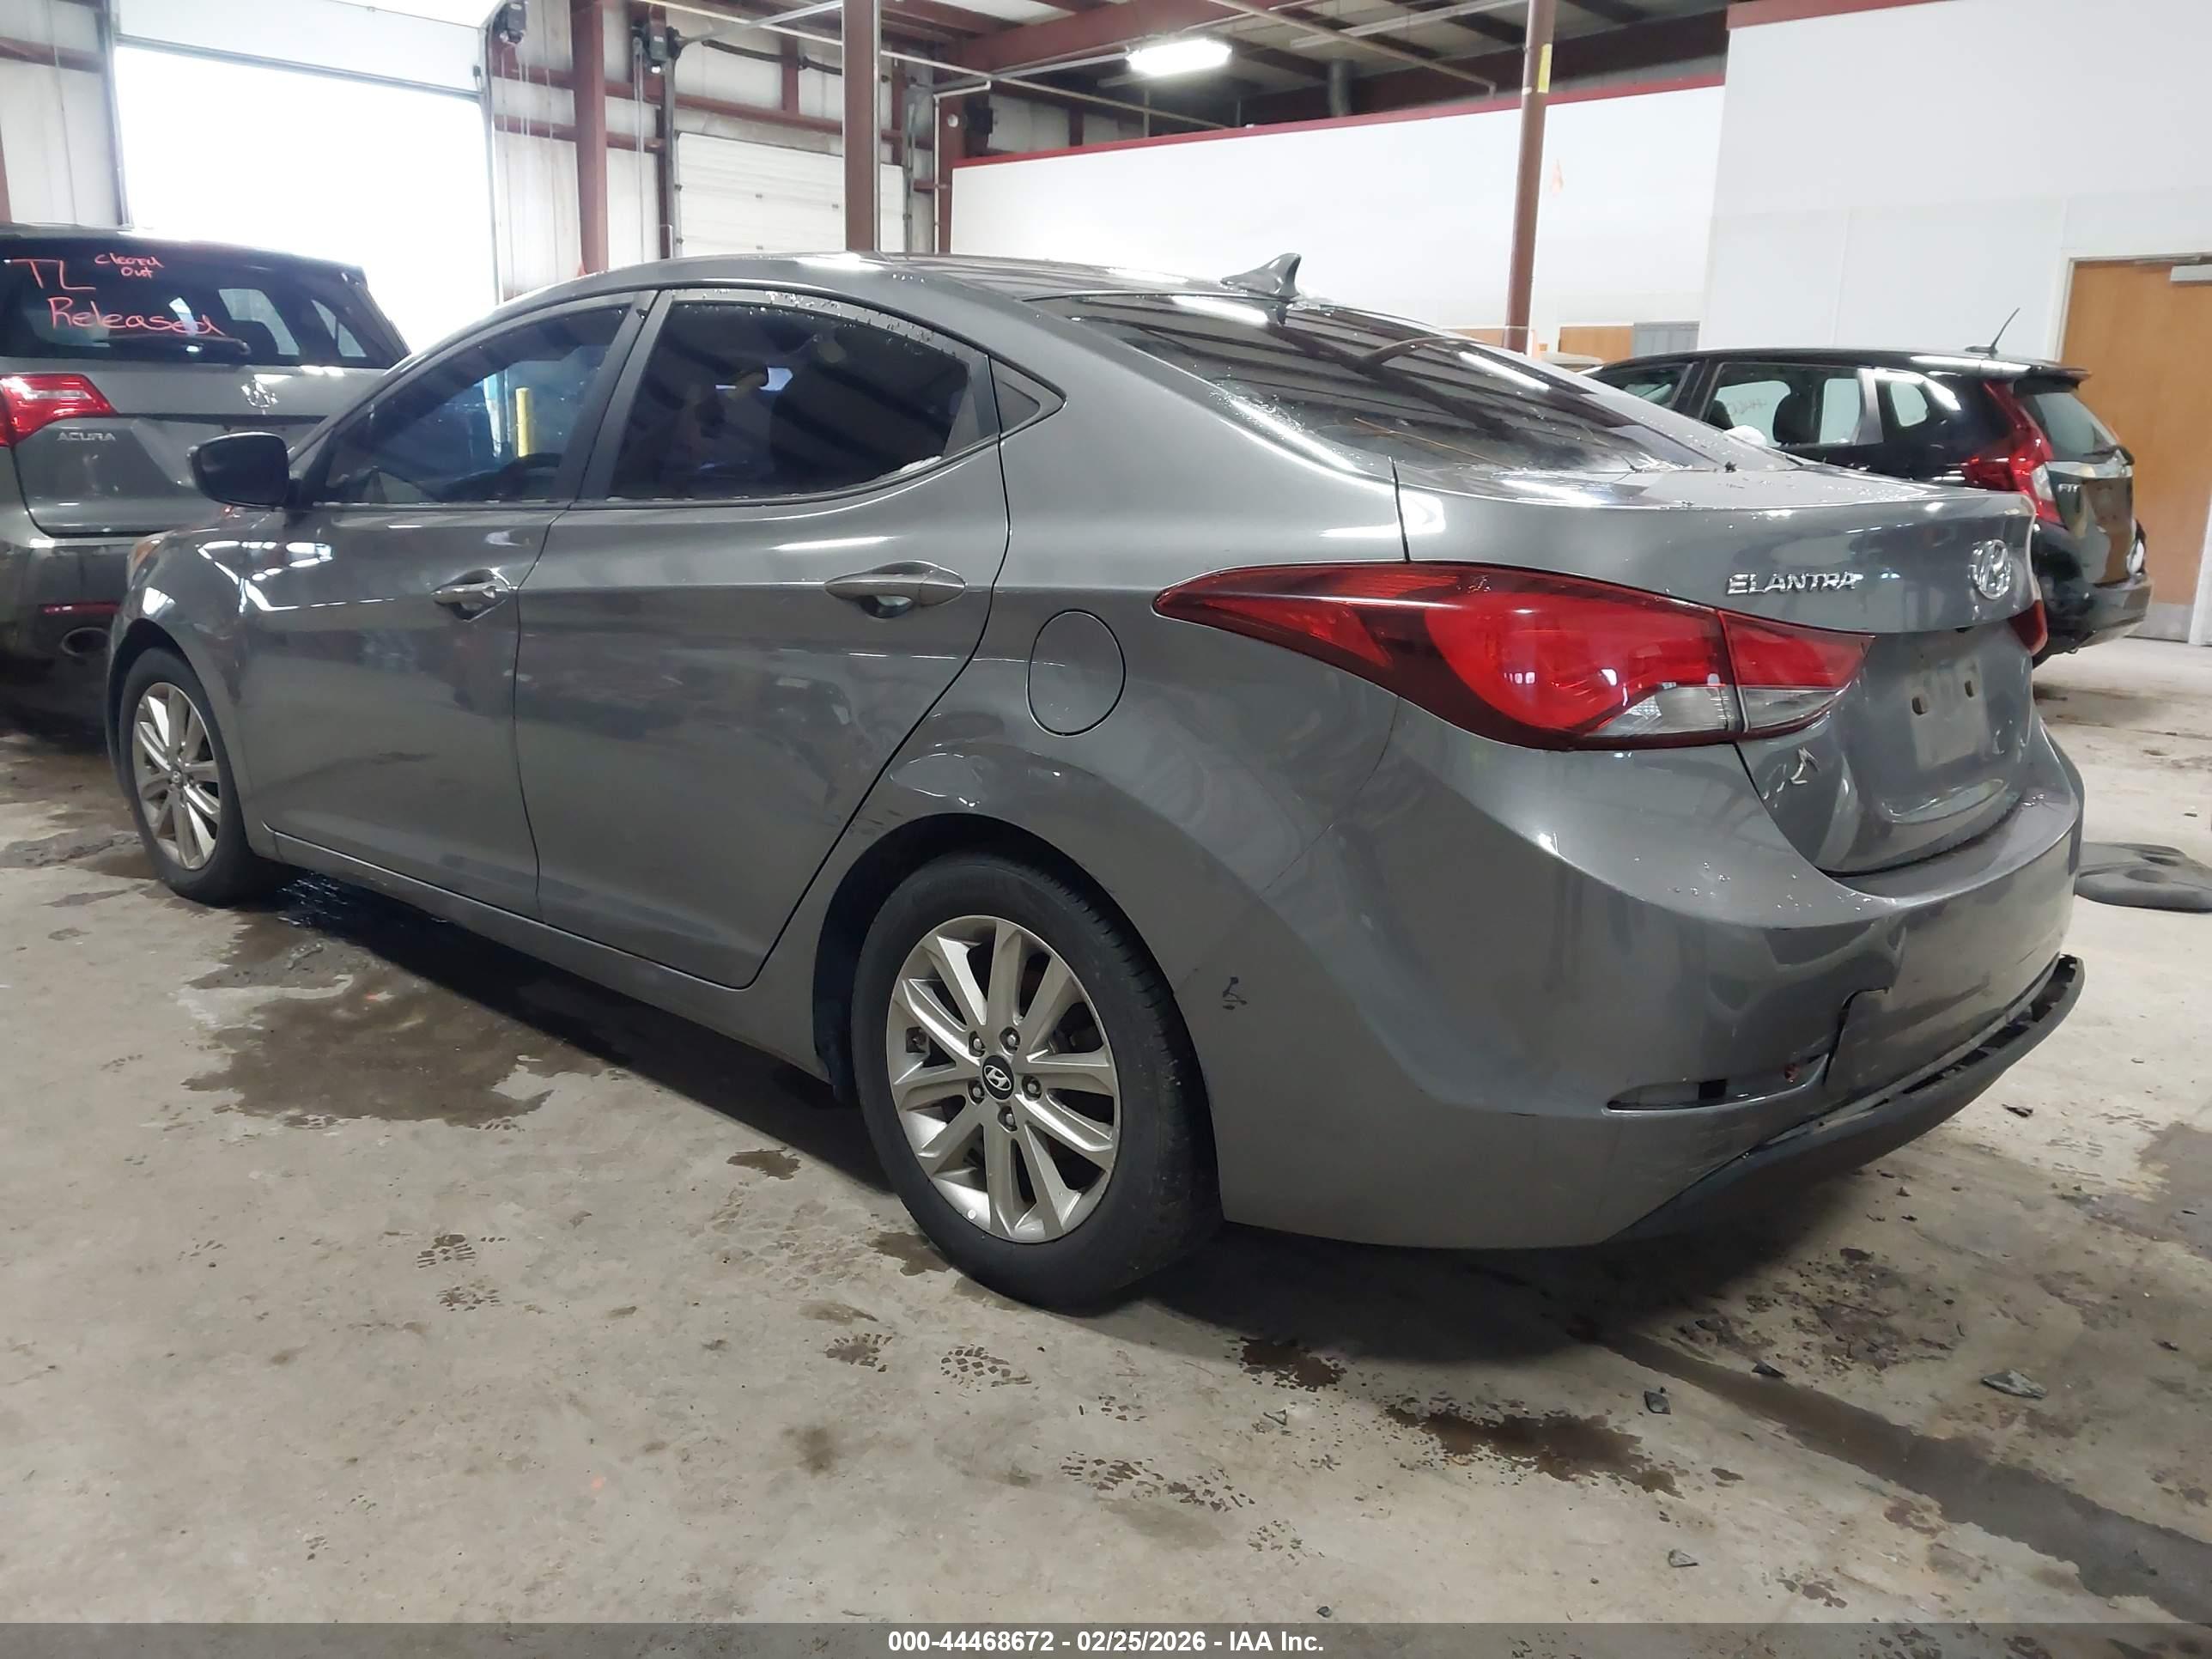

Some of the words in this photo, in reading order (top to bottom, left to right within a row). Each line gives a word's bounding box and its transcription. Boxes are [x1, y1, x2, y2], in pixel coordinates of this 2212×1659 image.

[4, 258, 96, 290] TL
[121, 266, 154, 279] Out
[47, 296, 225, 336] Released
[56, 431, 117, 441] ACURA
[2057, 483, 2081, 493] FIT
[1727, 570, 1864, 596] ELANTRA
